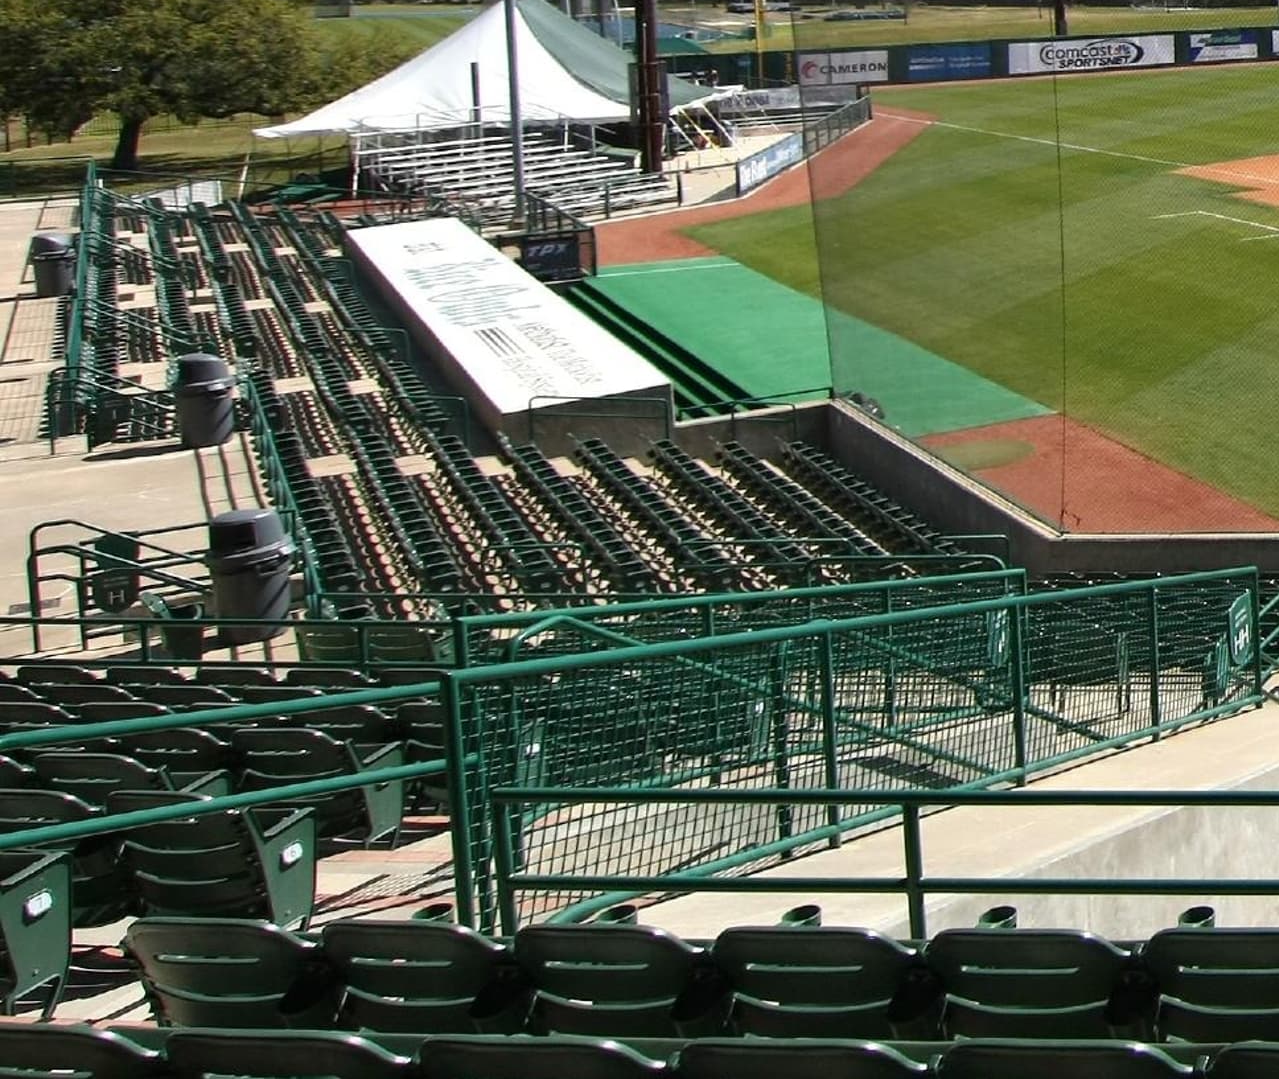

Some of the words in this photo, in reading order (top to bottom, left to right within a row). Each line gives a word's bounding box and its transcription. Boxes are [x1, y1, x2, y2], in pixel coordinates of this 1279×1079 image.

[1045, 44, 1112, 60] comcast
[819, 62, 888, 75] CAMERON
[1058, 54, 1132, 69] SPORTSNET
[527, 244, 567, 257] TPX
[1233, 623, 1250, 656] HH
